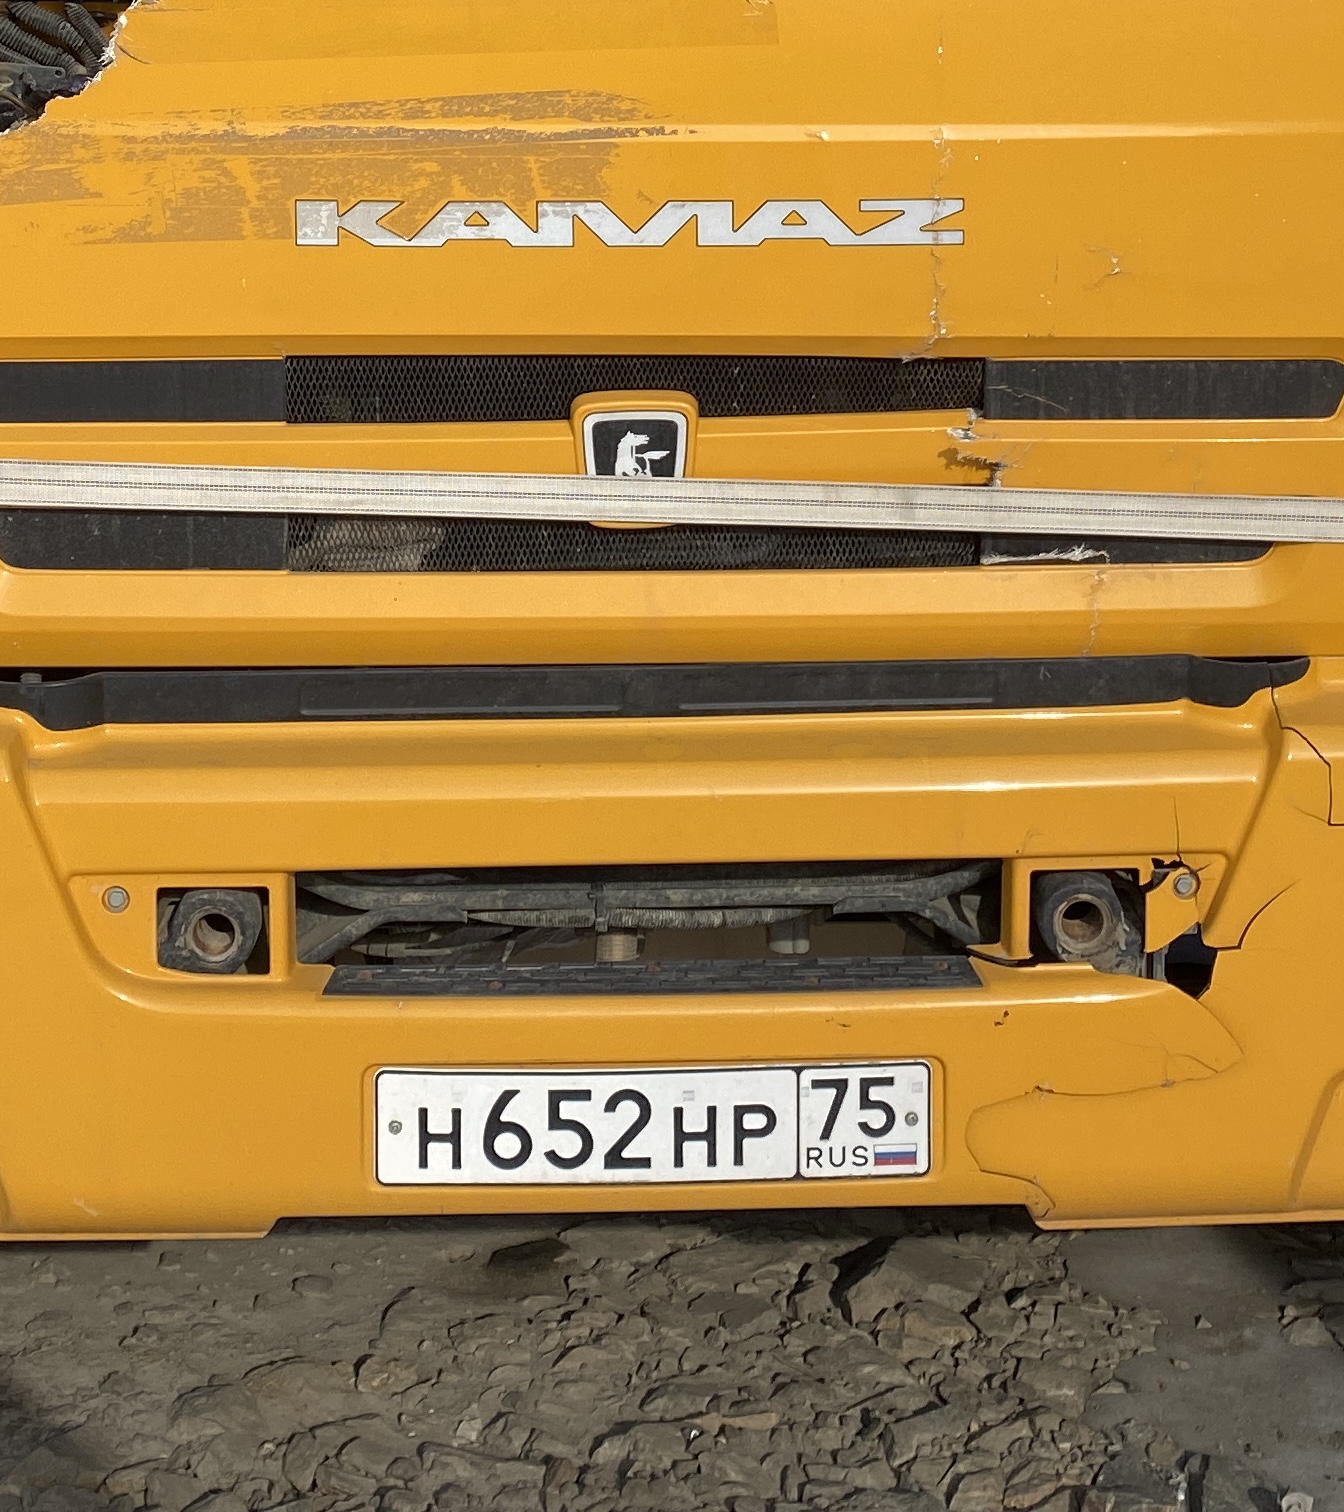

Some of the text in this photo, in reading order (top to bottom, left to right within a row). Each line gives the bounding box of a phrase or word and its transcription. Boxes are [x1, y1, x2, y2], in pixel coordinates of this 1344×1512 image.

[295, 198, 965, 246] KAMAZ
[810, 1076, 896, 1141] 75
[805, 1145, 870, 1169] RUS
